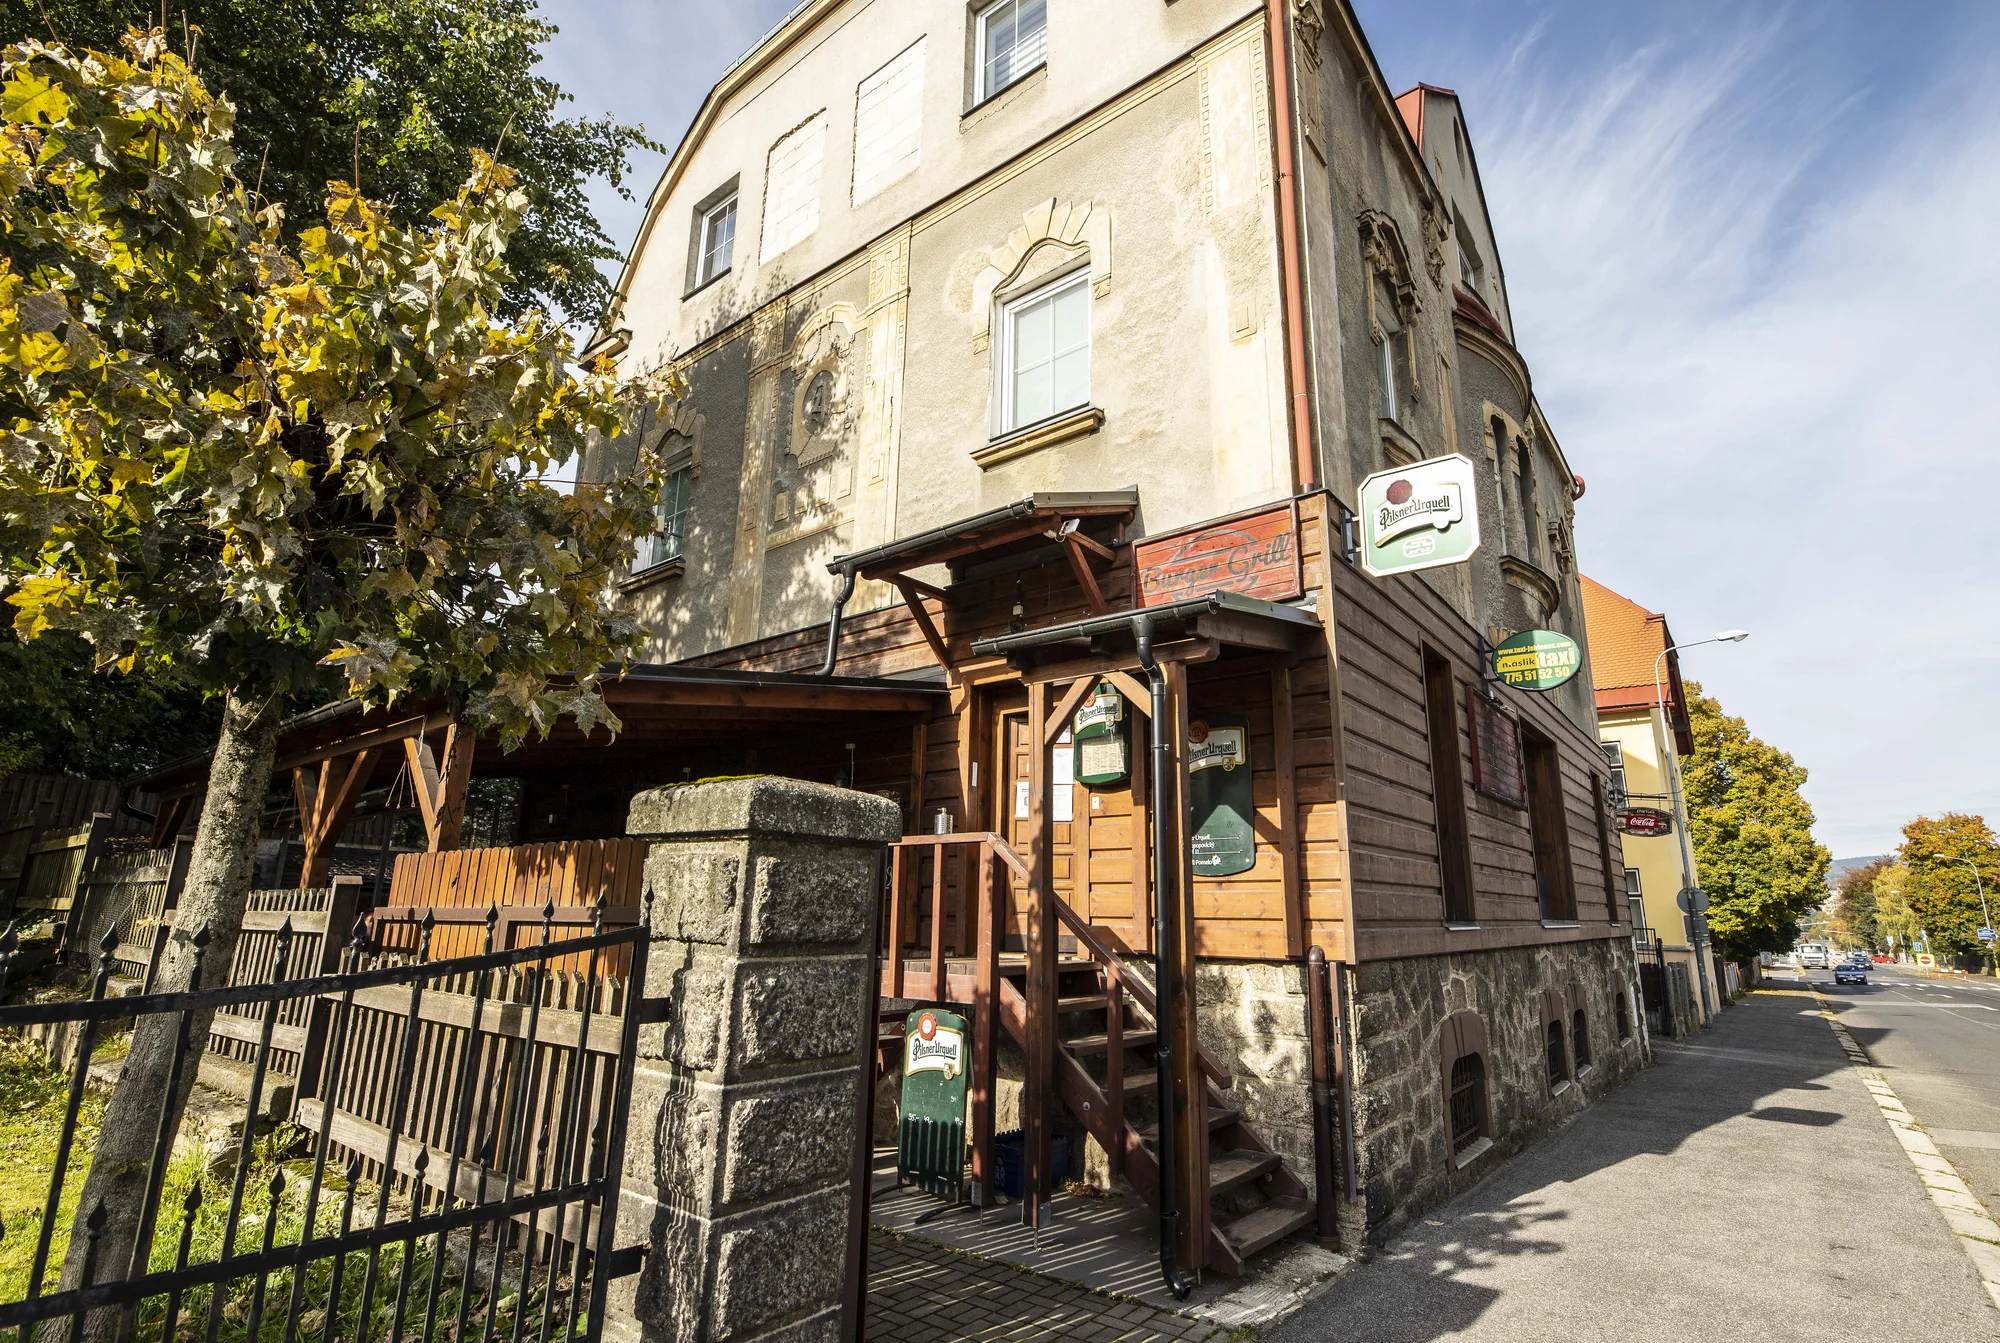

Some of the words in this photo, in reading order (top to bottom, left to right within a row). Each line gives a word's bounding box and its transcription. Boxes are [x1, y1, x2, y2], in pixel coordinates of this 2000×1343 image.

[1380, 503, 1414, 532] Pilsner
[1412, 495, 1451, 515] Urquell
[1141, 561, 1223, 598] Burger
[1227, 531, 1292, 583] Grill
[1538, 647, 1576, 668] taxi
[1504, 671, 1523, 684] 775
[1524, 669, 1537, 681] 51
[1538, 668, 1553, 680] 52
[1554, 666, 1571, 678] 50
[1189, 747, 1210, 762] ilsner
[1208, 740, 1237, 758] Urquell
[912, 1037, 936, 1062] Pilsner
[934, 1040, 957, 1060] Urquell
